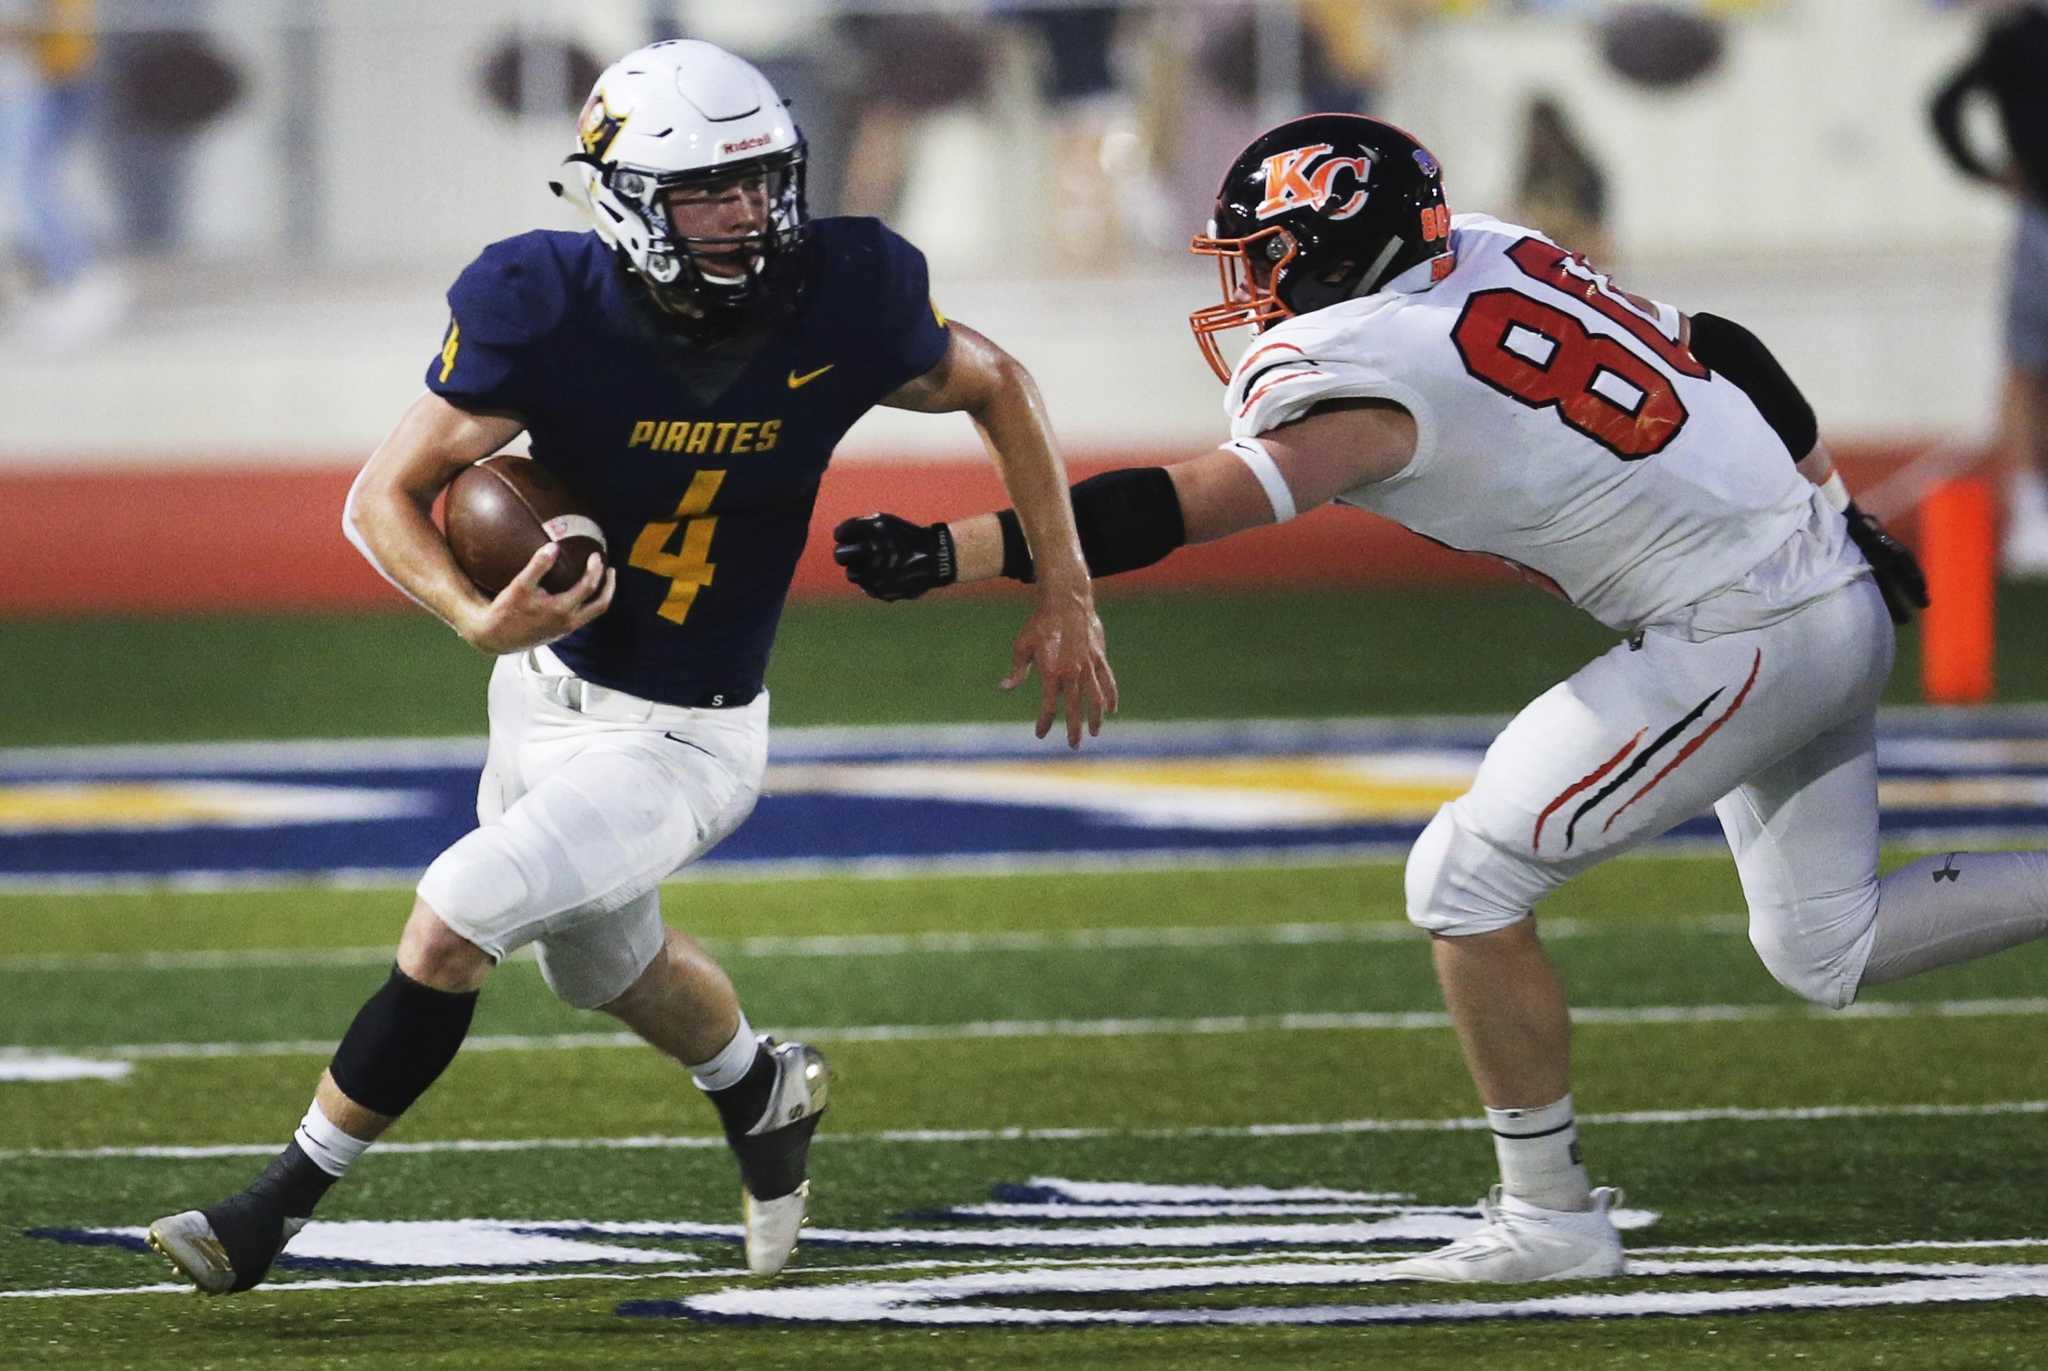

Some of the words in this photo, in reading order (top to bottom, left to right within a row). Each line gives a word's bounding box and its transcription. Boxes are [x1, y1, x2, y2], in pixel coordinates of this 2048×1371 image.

[1255, 143, 1372, 221] KC
[438, 318, 460, 384] 4
[627, 419, 783, 455] PIRATES
[627, 469, 728, 626] 4
[711, 694, 724, 707] S
